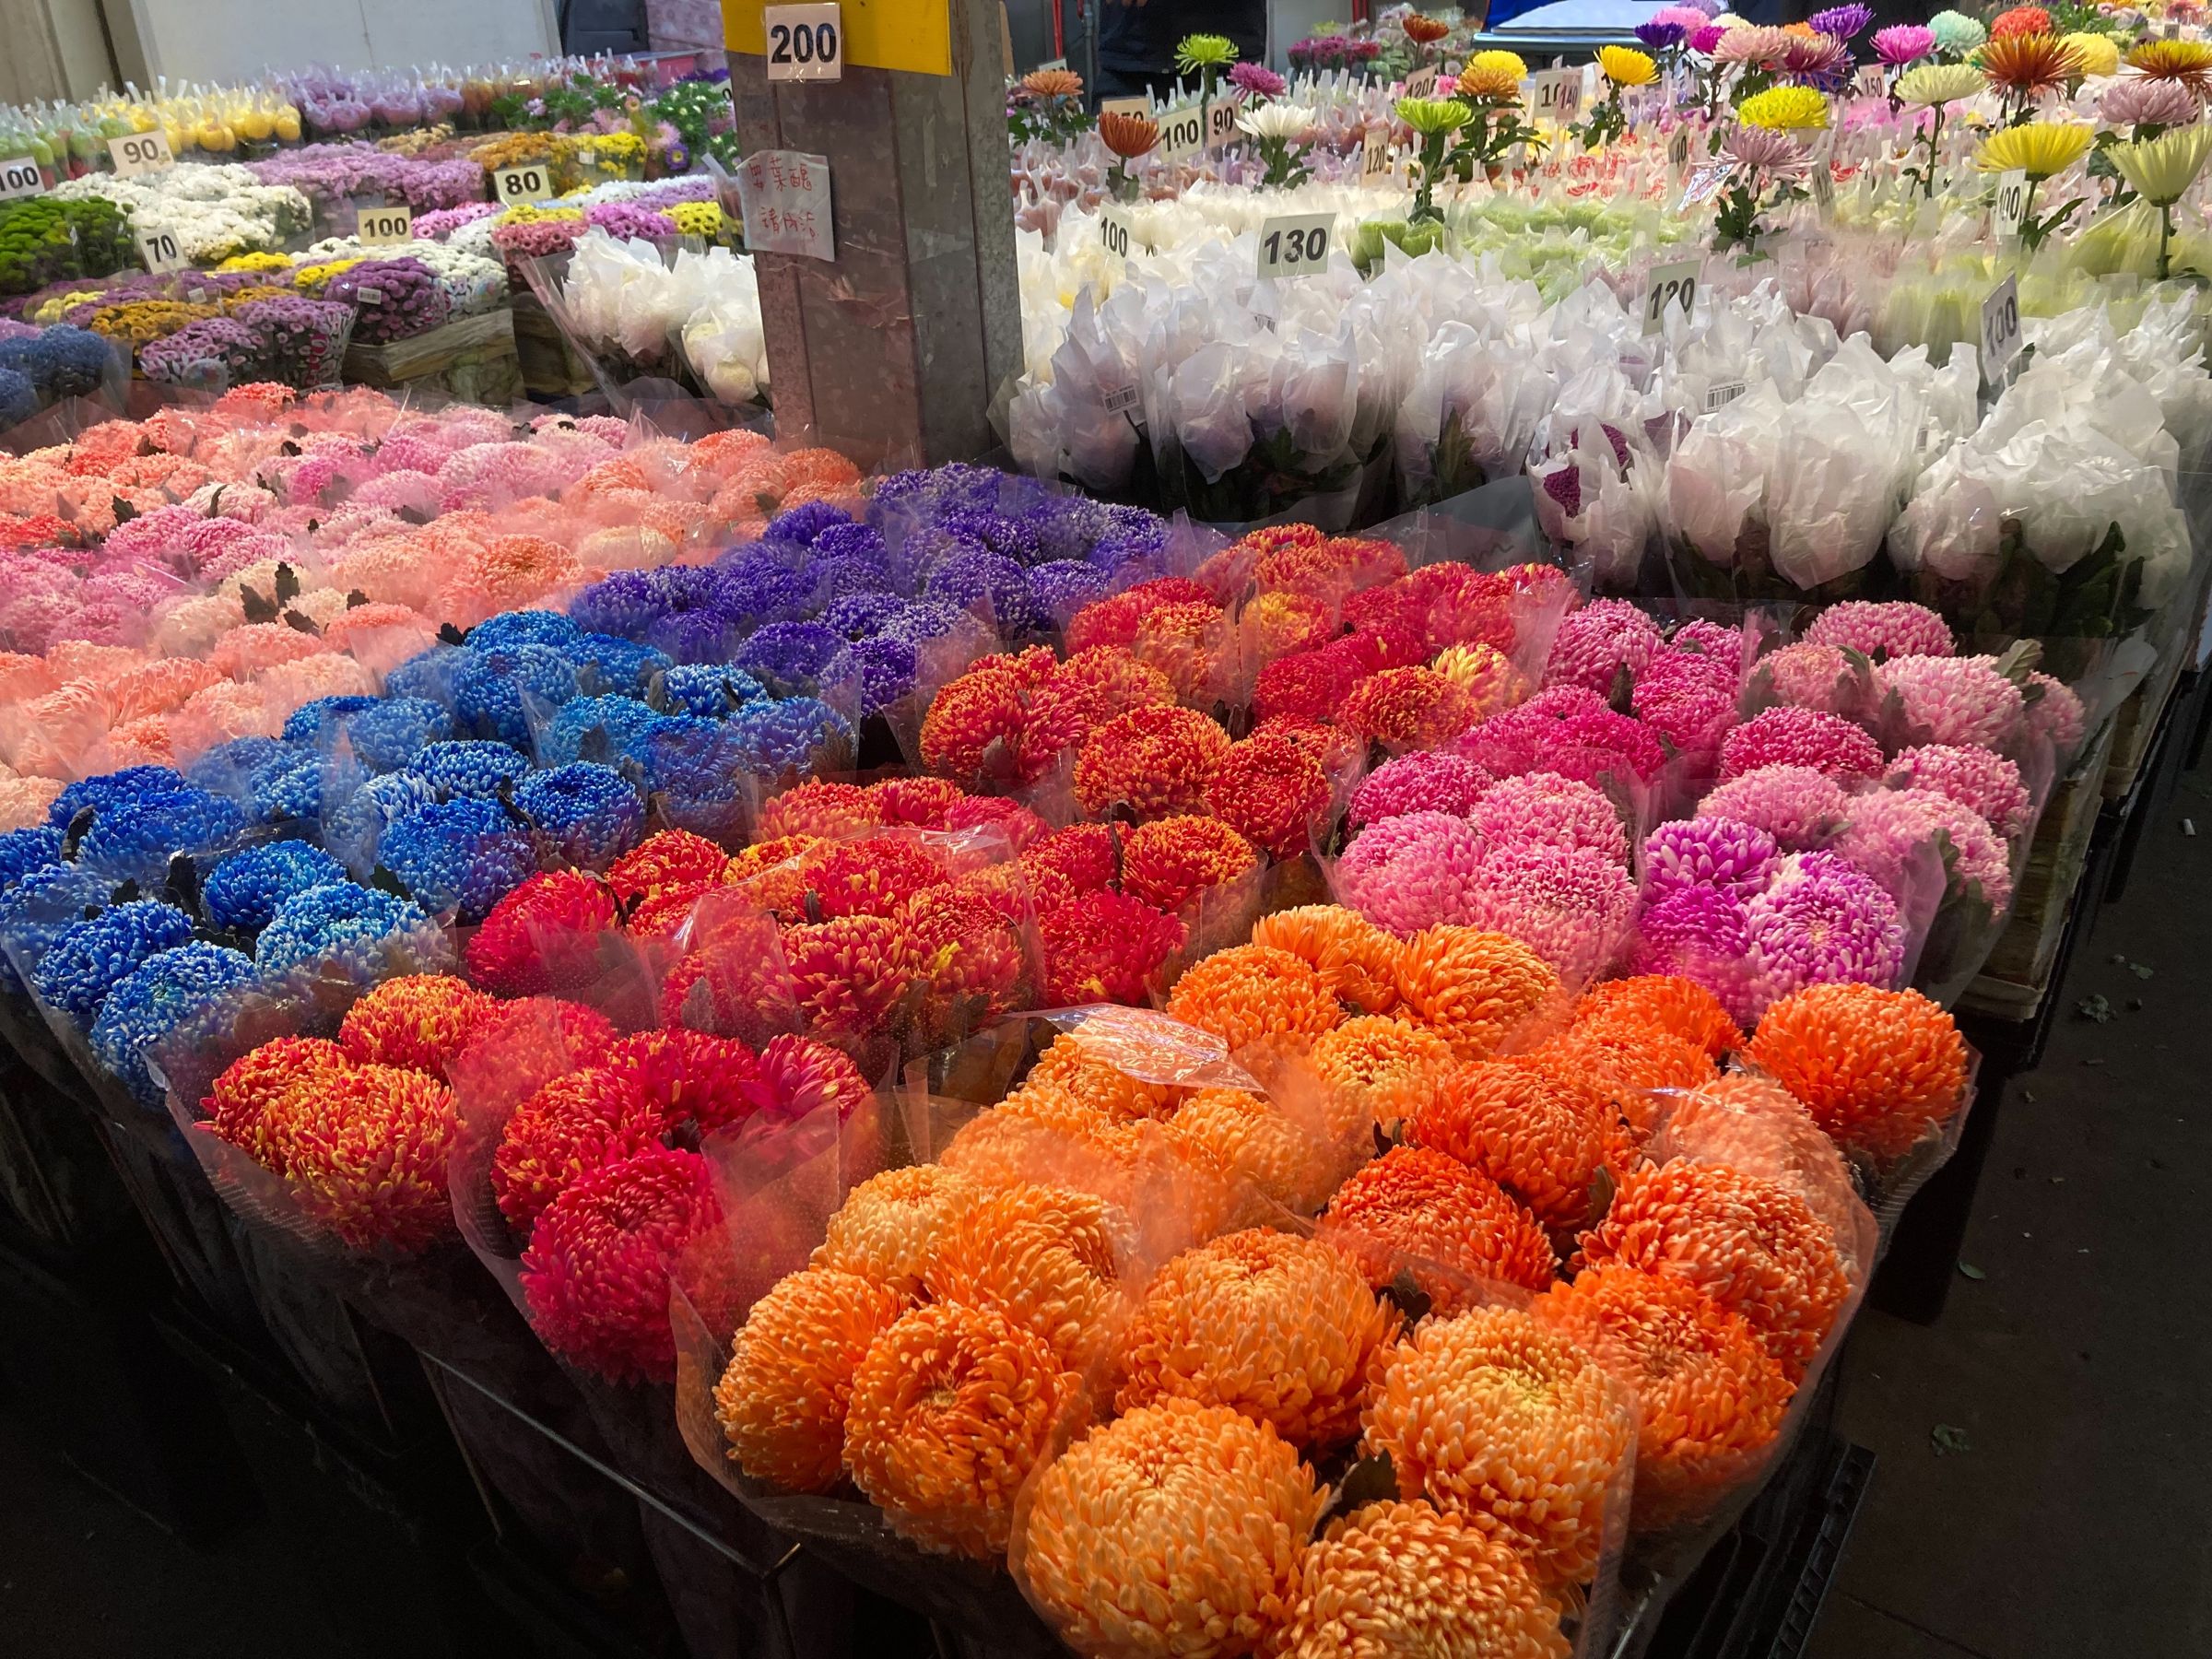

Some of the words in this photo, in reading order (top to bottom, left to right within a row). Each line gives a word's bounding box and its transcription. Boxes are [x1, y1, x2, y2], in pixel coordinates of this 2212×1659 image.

[771, 23, 837, 64] 200
[1164, 119, 1199, 152] 100
[1213, 107, 1233, 135] 90
[124, 138, 159, 164] 90
[1365, 145, 1385, 175] 120
[505, 171, 541, 196] 80
[364, 218, 407, 238] 100
[1100, 217, 1128, 258] 100
[146, 234, 177, 264] 70
[1264, 227, 1327, 265] 130
[1986, 295, 2018, 358] 100
